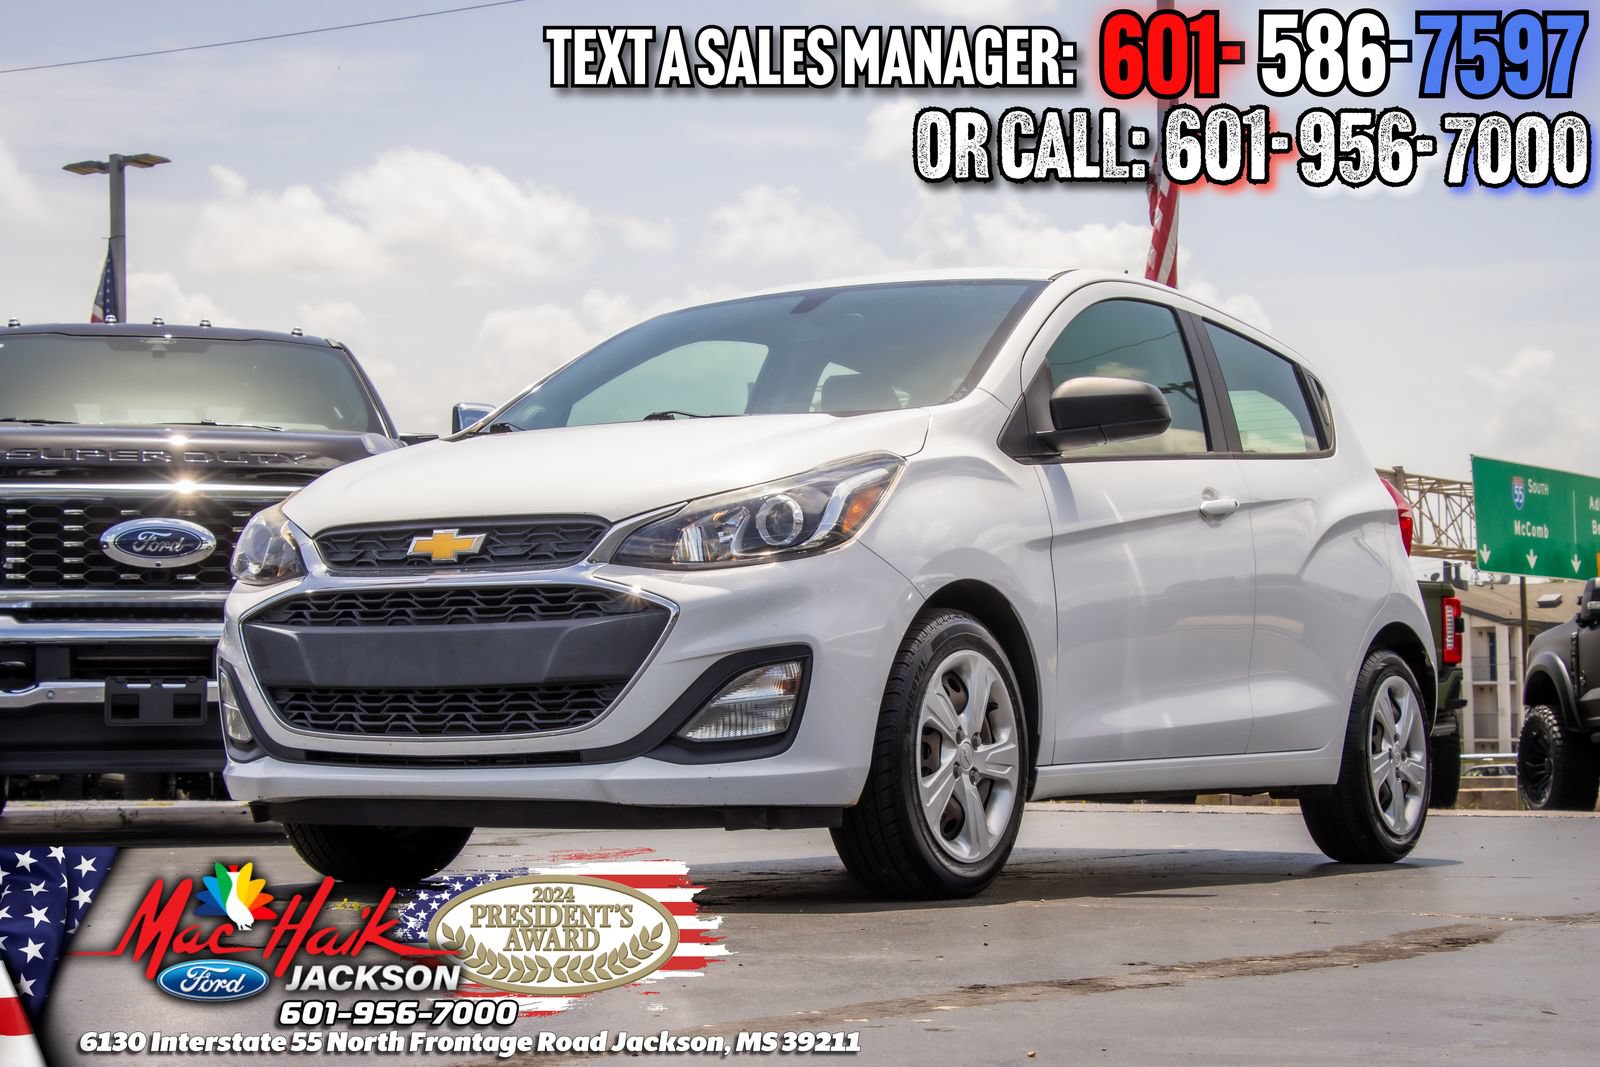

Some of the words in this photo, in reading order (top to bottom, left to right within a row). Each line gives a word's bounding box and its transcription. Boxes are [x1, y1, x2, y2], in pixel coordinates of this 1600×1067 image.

[5, 447, 172, 463] SUPER
[183, 450, 308, 466] DUTY
[1513, 485, 1525, 503] 55
[1514, 519, 1549, 539] McComb
[132, 531, 187, 553] Ford
